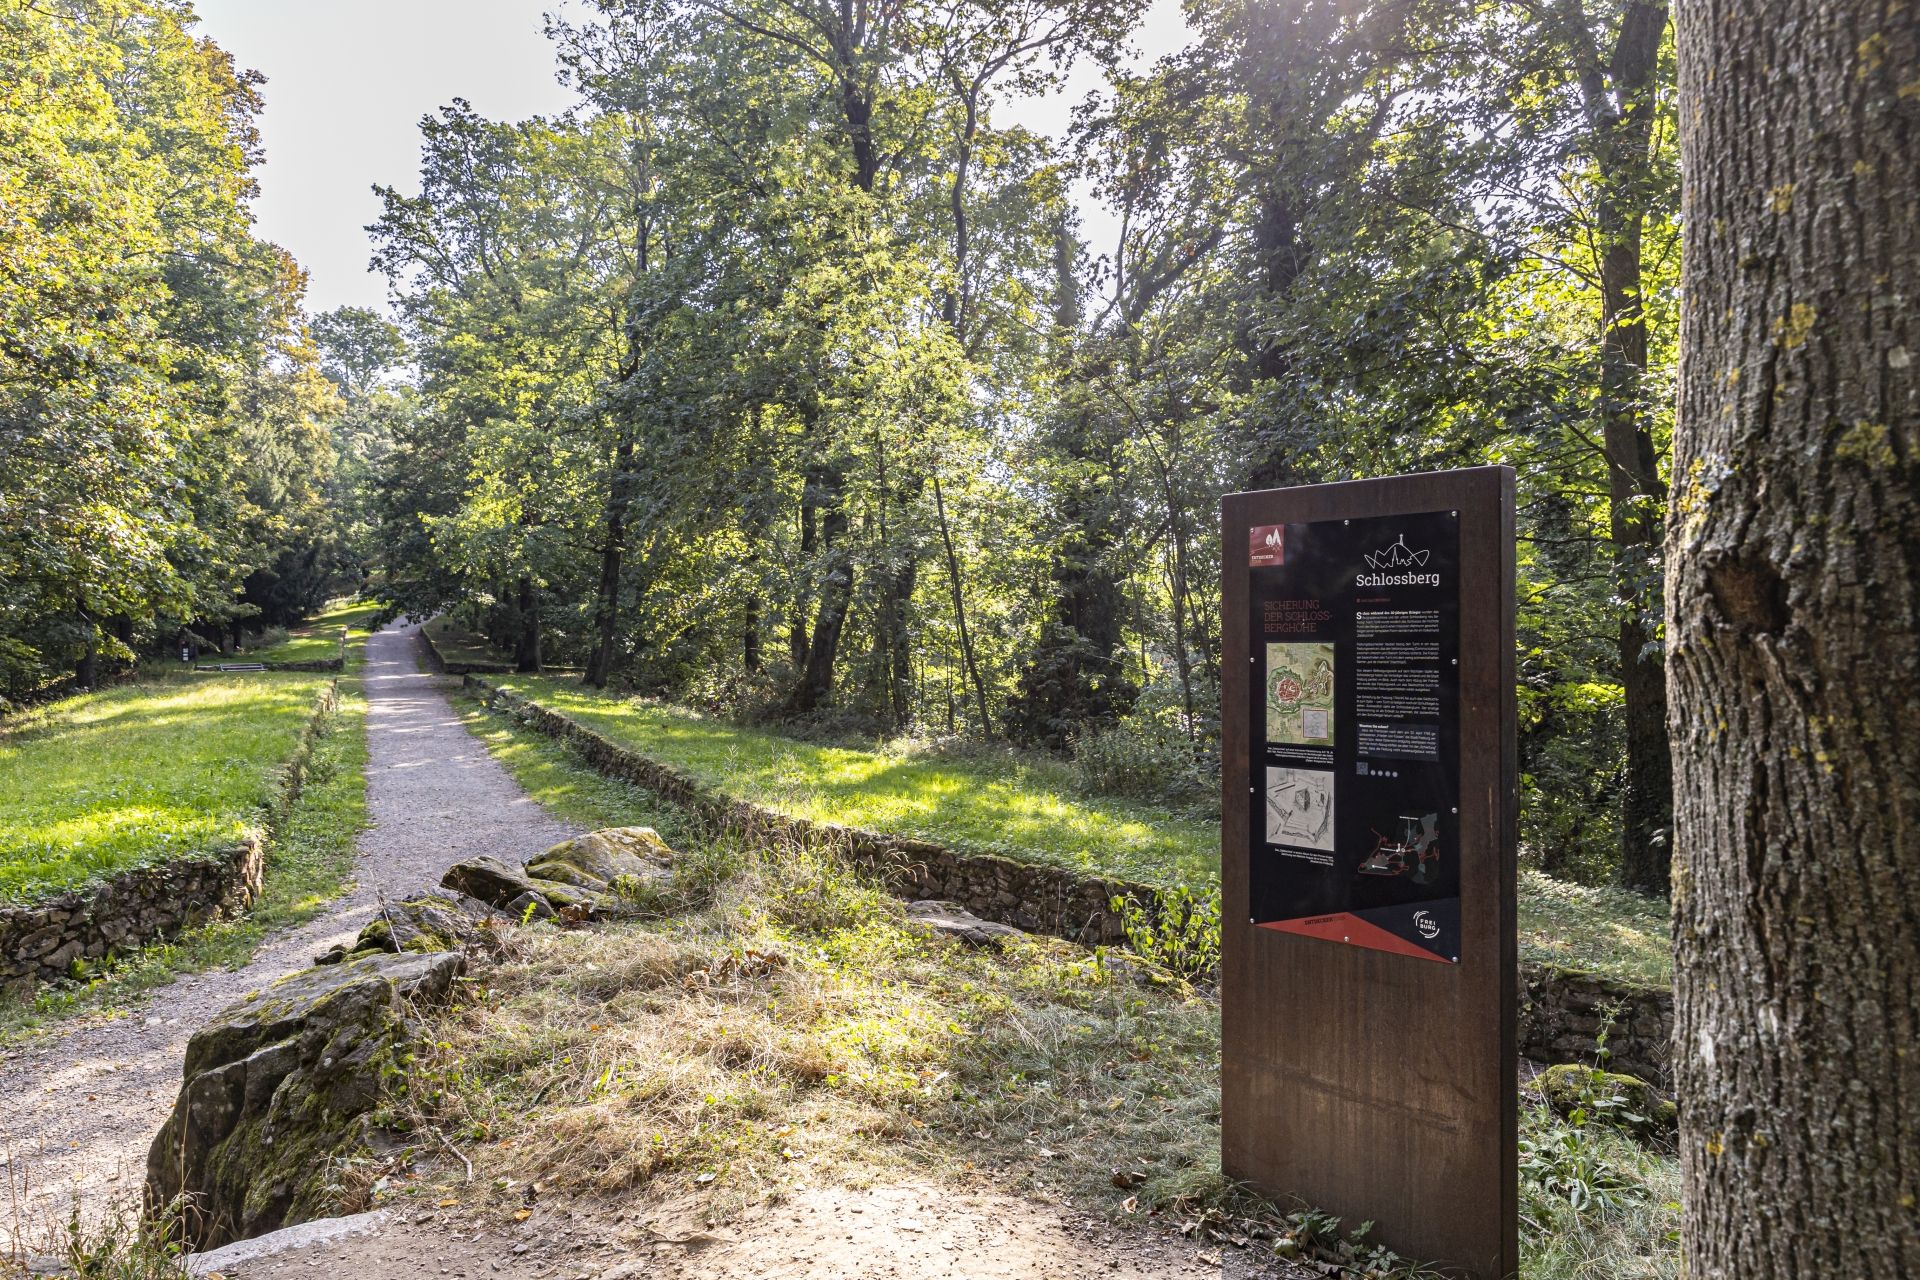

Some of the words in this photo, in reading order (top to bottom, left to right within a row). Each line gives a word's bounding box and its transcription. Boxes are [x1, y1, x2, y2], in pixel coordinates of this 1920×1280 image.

[1356, 571, 1440, 587] Schlossberg
[1264, 599, 1320, 611] SICHERUNG
[1264, 611, 1284, 622] DER
[1419, 918, 1436, 926] FREI
[1419, 923, 1436, 931] BURG
